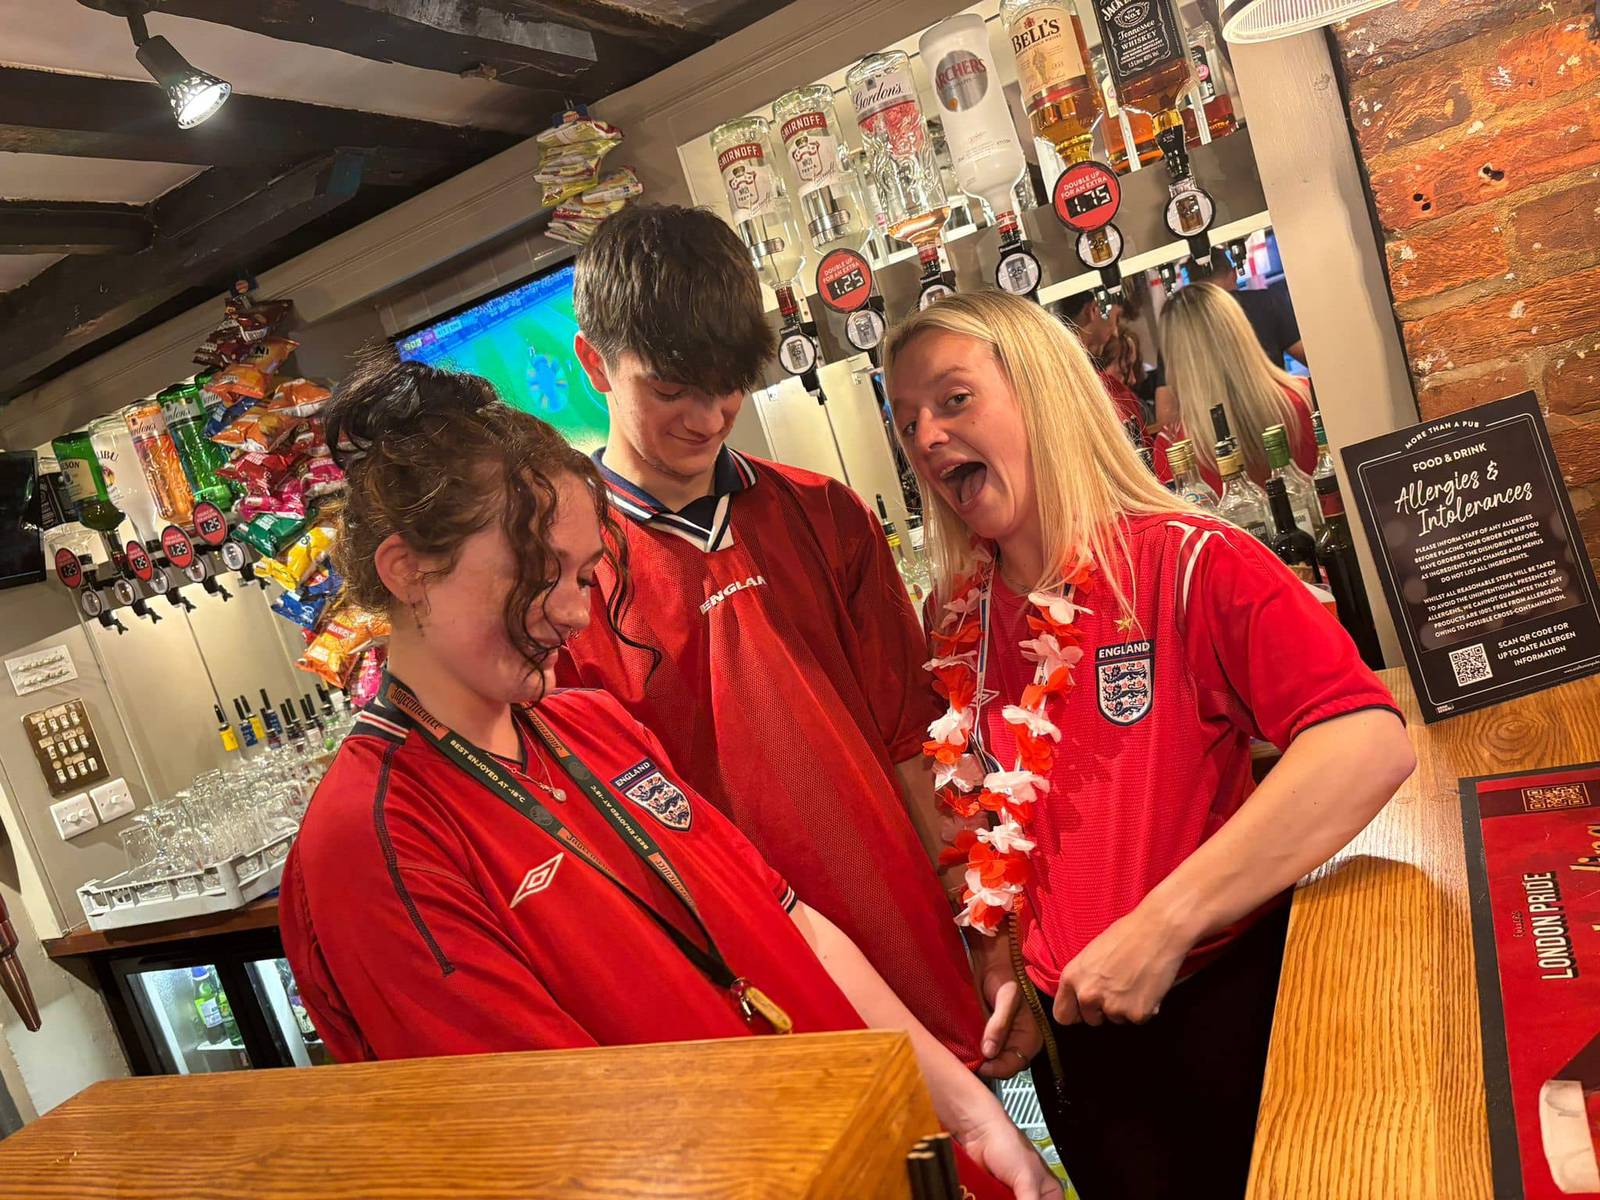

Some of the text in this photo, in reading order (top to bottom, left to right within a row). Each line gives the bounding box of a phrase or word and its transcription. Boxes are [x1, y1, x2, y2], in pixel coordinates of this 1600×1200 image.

[1102, 0, 1124, 21] JACK
[1012, 18, 1060, 54] BELL'S
[1118, 20, 1155, 40] Tennessee
[1121, 30, 1156, 50] WHISKEY
[854, 82, 902, 110] Gordon's
[1061, 176, 1107, 199] FOR AN EXTRA
[1064, 171, 1100, 190] DOUBLE UP
[1074, 184, 1110, 212] 1.75
[823, 262, 860, 284] FOR AN EXTRA
[824, 257, 854, 276] DOUBLE UP
[834, 270, 864, 296] 1.25
[1404, 430, 1428, 449] MORE
[1428, 422, 1452, 434] THAN
[1412, 442, 1488, 473] FOOD & DRINK
[1394, 460, 1498, 515] Allergies &
[1417, 482, 1532, 537] Intolerances
[204, 518, 222, 533] 1.25
[1415, 542, 1437, 554] PLEASE
[1437, 536, 1462, 549] INFORM
[1461, 531, 1479, 541] STAFF
[1488, 523, 1502, 532] ANY
[1502, 514, 1533, 528] ALLERGIES
[170, 542, 188, 556] 1.25
[1414, 522, 1540, 564] BEFORE PLACING YOUR ORDER EVEN IF YOU
[1420, 530, 1540, 571] HAVE ORDERED THE DISH/DRINK BEFORE,
[1429, 562, 1468, 578] INGREDIENTS
[1468, 557, 1482, 566] CAN
[1482, 550, 1508, 562] CHANGE
[1508, 545, 1522, 553] AND
[1522, 538, 1544, 550] MENUS
[1440, 552, 1530, 584] DO NOT LIST ALL INGREDIENTS.
[699, 576, 768, 615] ENGLAN
[1423, 592, 1446, 604] WHILST
[1446, 588, 1456, 597] ALL
[1456, 578, 1494, 594] REASONABLE
[1494, 572, 1514, 583] STEPS
[1513, 568, 1528, 578] WILL
[1536, 560, 1556, 571] TAKEN
[1437, 600, 1456, 610] AVOID
[1456, 595, 1468, 604] THE
[1468, 582, 1518, 600] UNINTENTIONAL
[1517, 572, 1548, 585] PRESENCE
[1547, 568, 1557, 576] OF
[1428, 606, 1464, 622] ALLERGENS,
[1472, 596, 1498, 608] CANNOT
[1498, 584, 1534, 600] GUARANTEE
[1534, 580, 1550, 590] THAT
[1550, 576, 1563, 585] ANY
[1434, 586, 1562, 629] PRODUCTS ARE 100% FREE FROM ALLERGENS,
[1434, 594, 1566, 638] OWING TO POSSIBLE CROSS-CONTAMINATION.
[1497, 631, 1576, 660] UP TO DATE ALLERGEN
[1498, 622, 1570, 649] SCAN QR CODE FOR
[1098, 642, 1150, 658] ENGLAND
[1514, 646, 1567, 666] INFORMATION
[450, 740, 469, 756] BEST
[467, 754, 499, 782] ENJOYED
[498, 780, 509, 790] AT
[614, 761, 650, 787] ENGLAND
[603, 799, 612, 808] AT
[610, 807, 636, 836] ENJOYED
[633, 832, 650, 850] BEST
[1524, 872, 1574, 981] LONDON PRIDE
